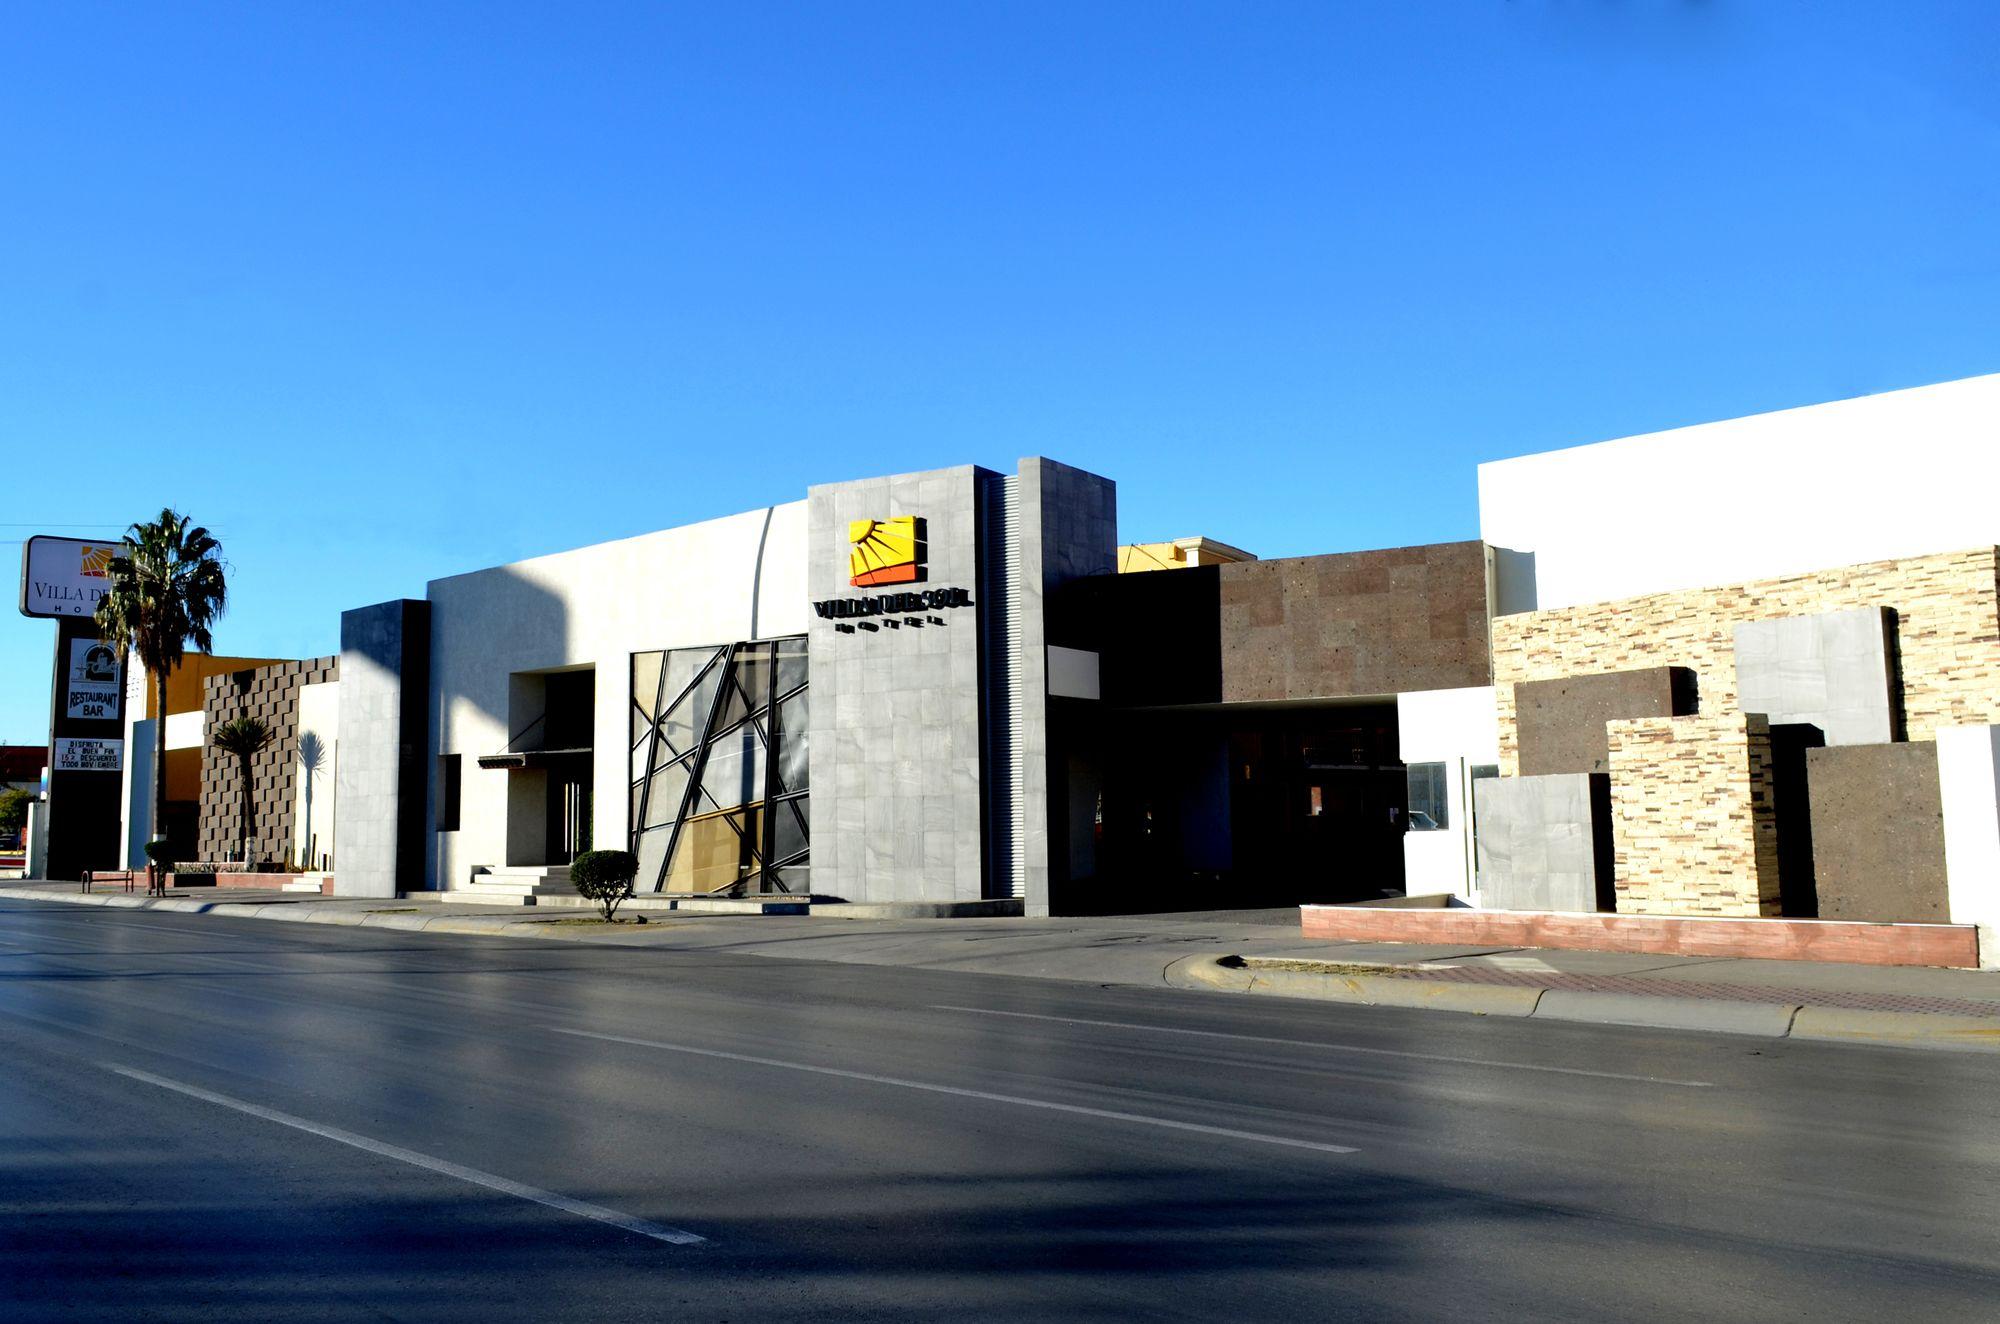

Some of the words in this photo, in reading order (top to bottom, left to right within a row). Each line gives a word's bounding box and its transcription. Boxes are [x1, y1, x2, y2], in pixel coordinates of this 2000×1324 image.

[35, 582, 83, 600] VILLA
[812, 597, 875, 619] VILLA
[876, 592, 920, 614] DEL
[921, 588, 974, 609] SOL
[835, 616, 947, 634] HOTEL
[70, 691, 118, 709] RESTAURANT
[83, 704, 104, 717] BAR
[80, 761, 119, 769] NOVIEMBRE
